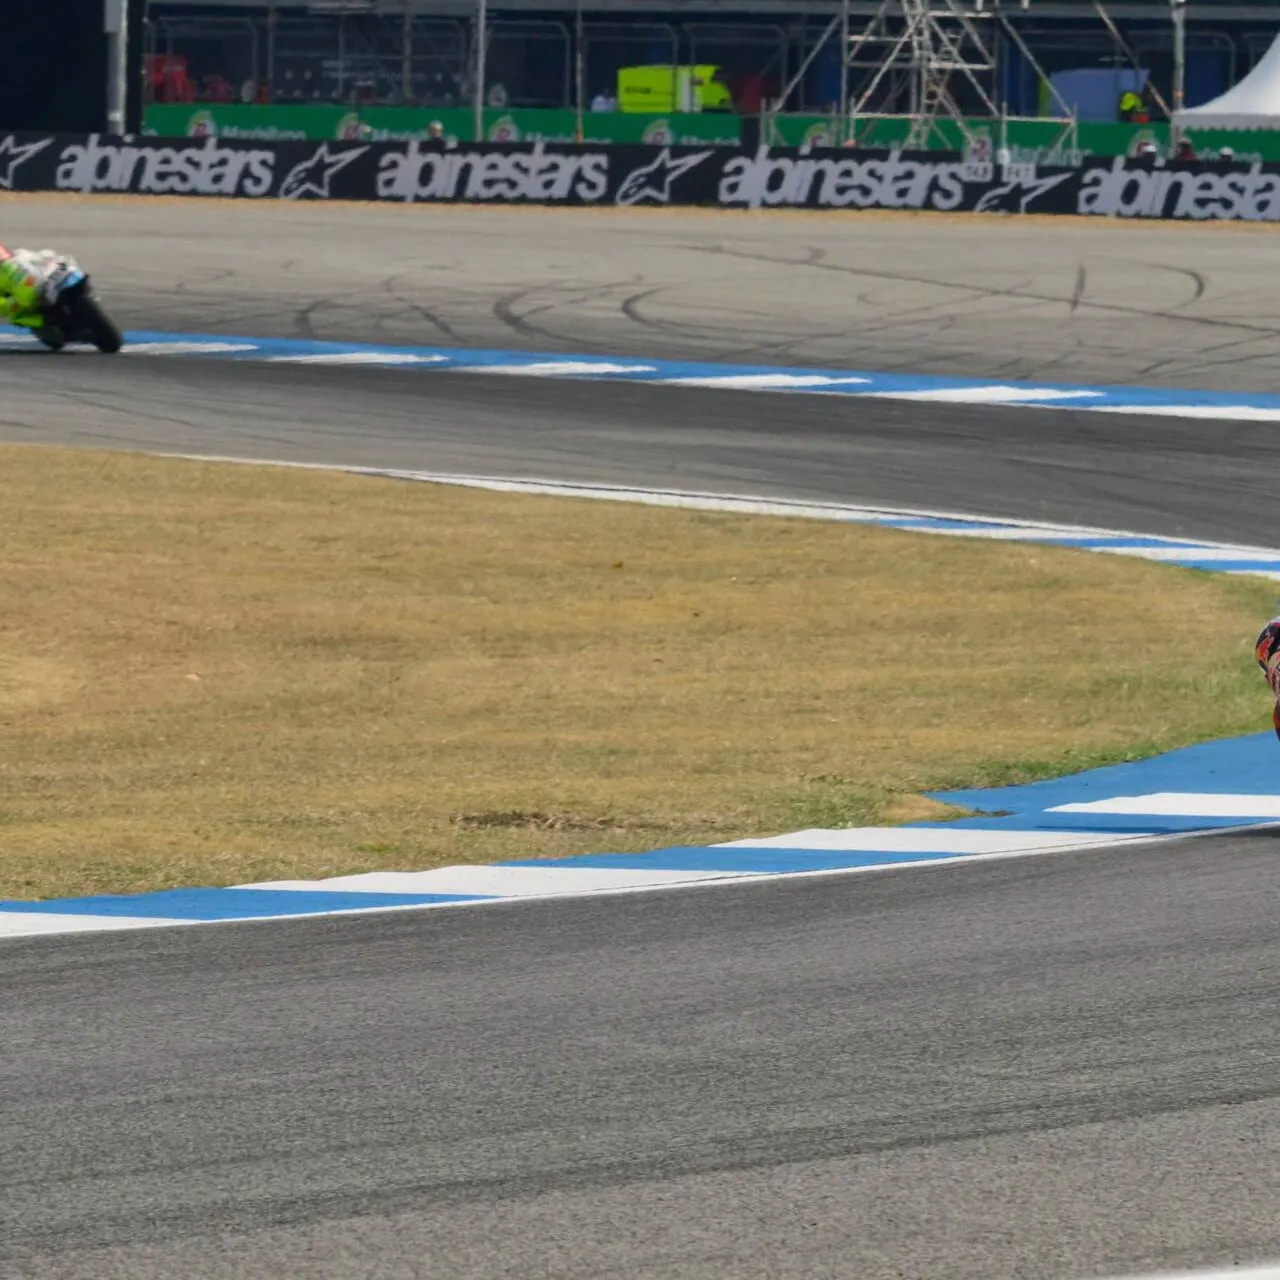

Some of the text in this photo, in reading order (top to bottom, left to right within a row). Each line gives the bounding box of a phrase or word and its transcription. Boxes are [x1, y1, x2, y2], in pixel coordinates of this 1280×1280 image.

[56, 133, 275, 195] alpinestars
[377, 141, 609, 202] alpinestars
[719, 144, 963, 211] alpinestars
